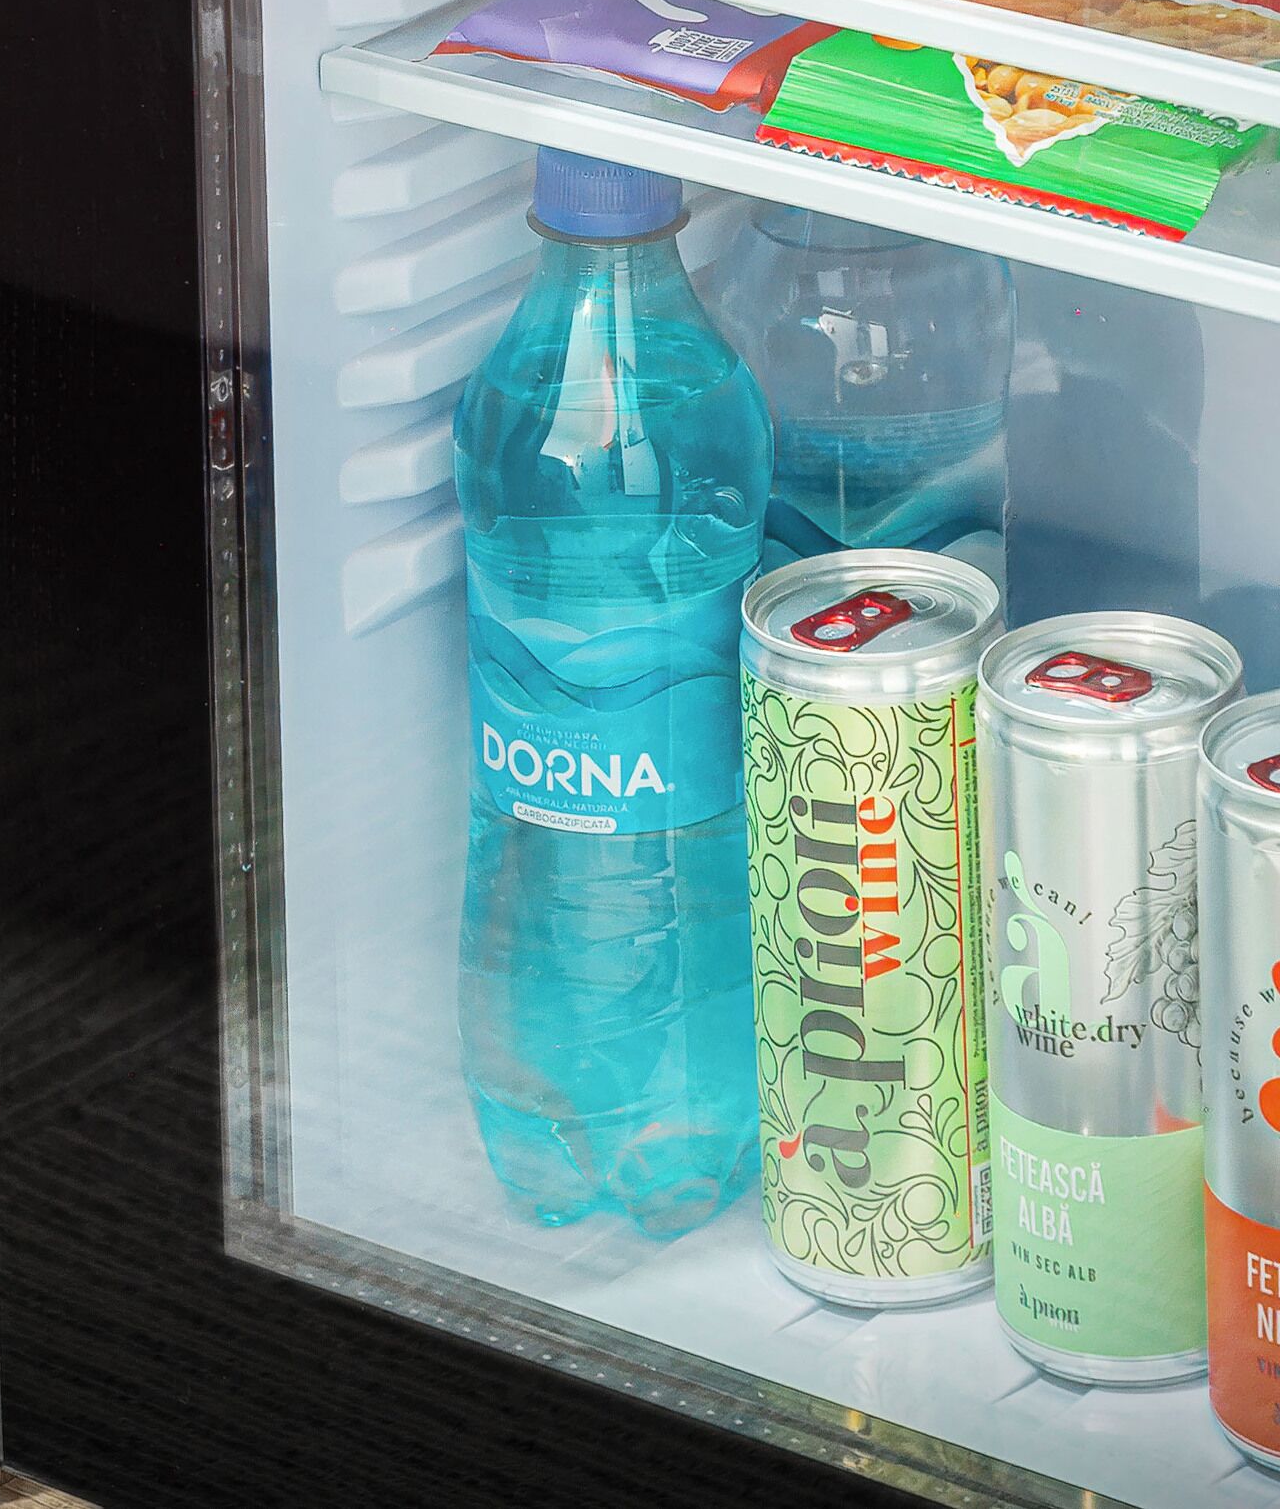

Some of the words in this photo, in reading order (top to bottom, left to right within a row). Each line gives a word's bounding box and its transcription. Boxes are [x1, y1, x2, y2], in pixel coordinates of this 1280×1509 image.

[483, 722, 666, 798] DORNA
[858, 794, 902, 981] wine
[1033, 882, 1094, 926] can!
[1015, 1002, 1147, 1049] white.dry
[1016, 1025, 1075, 1059] wine
[999, 1135, 1106, 1205] FETEASCĂ
[1019, 1194, 1073, 1247] ALBĂ
[1010, 1240, 1030, 1265] VIN
[1035, 1253, 1061, 1276] SEC
[1067, 1263, 1097, 1283] ALB
